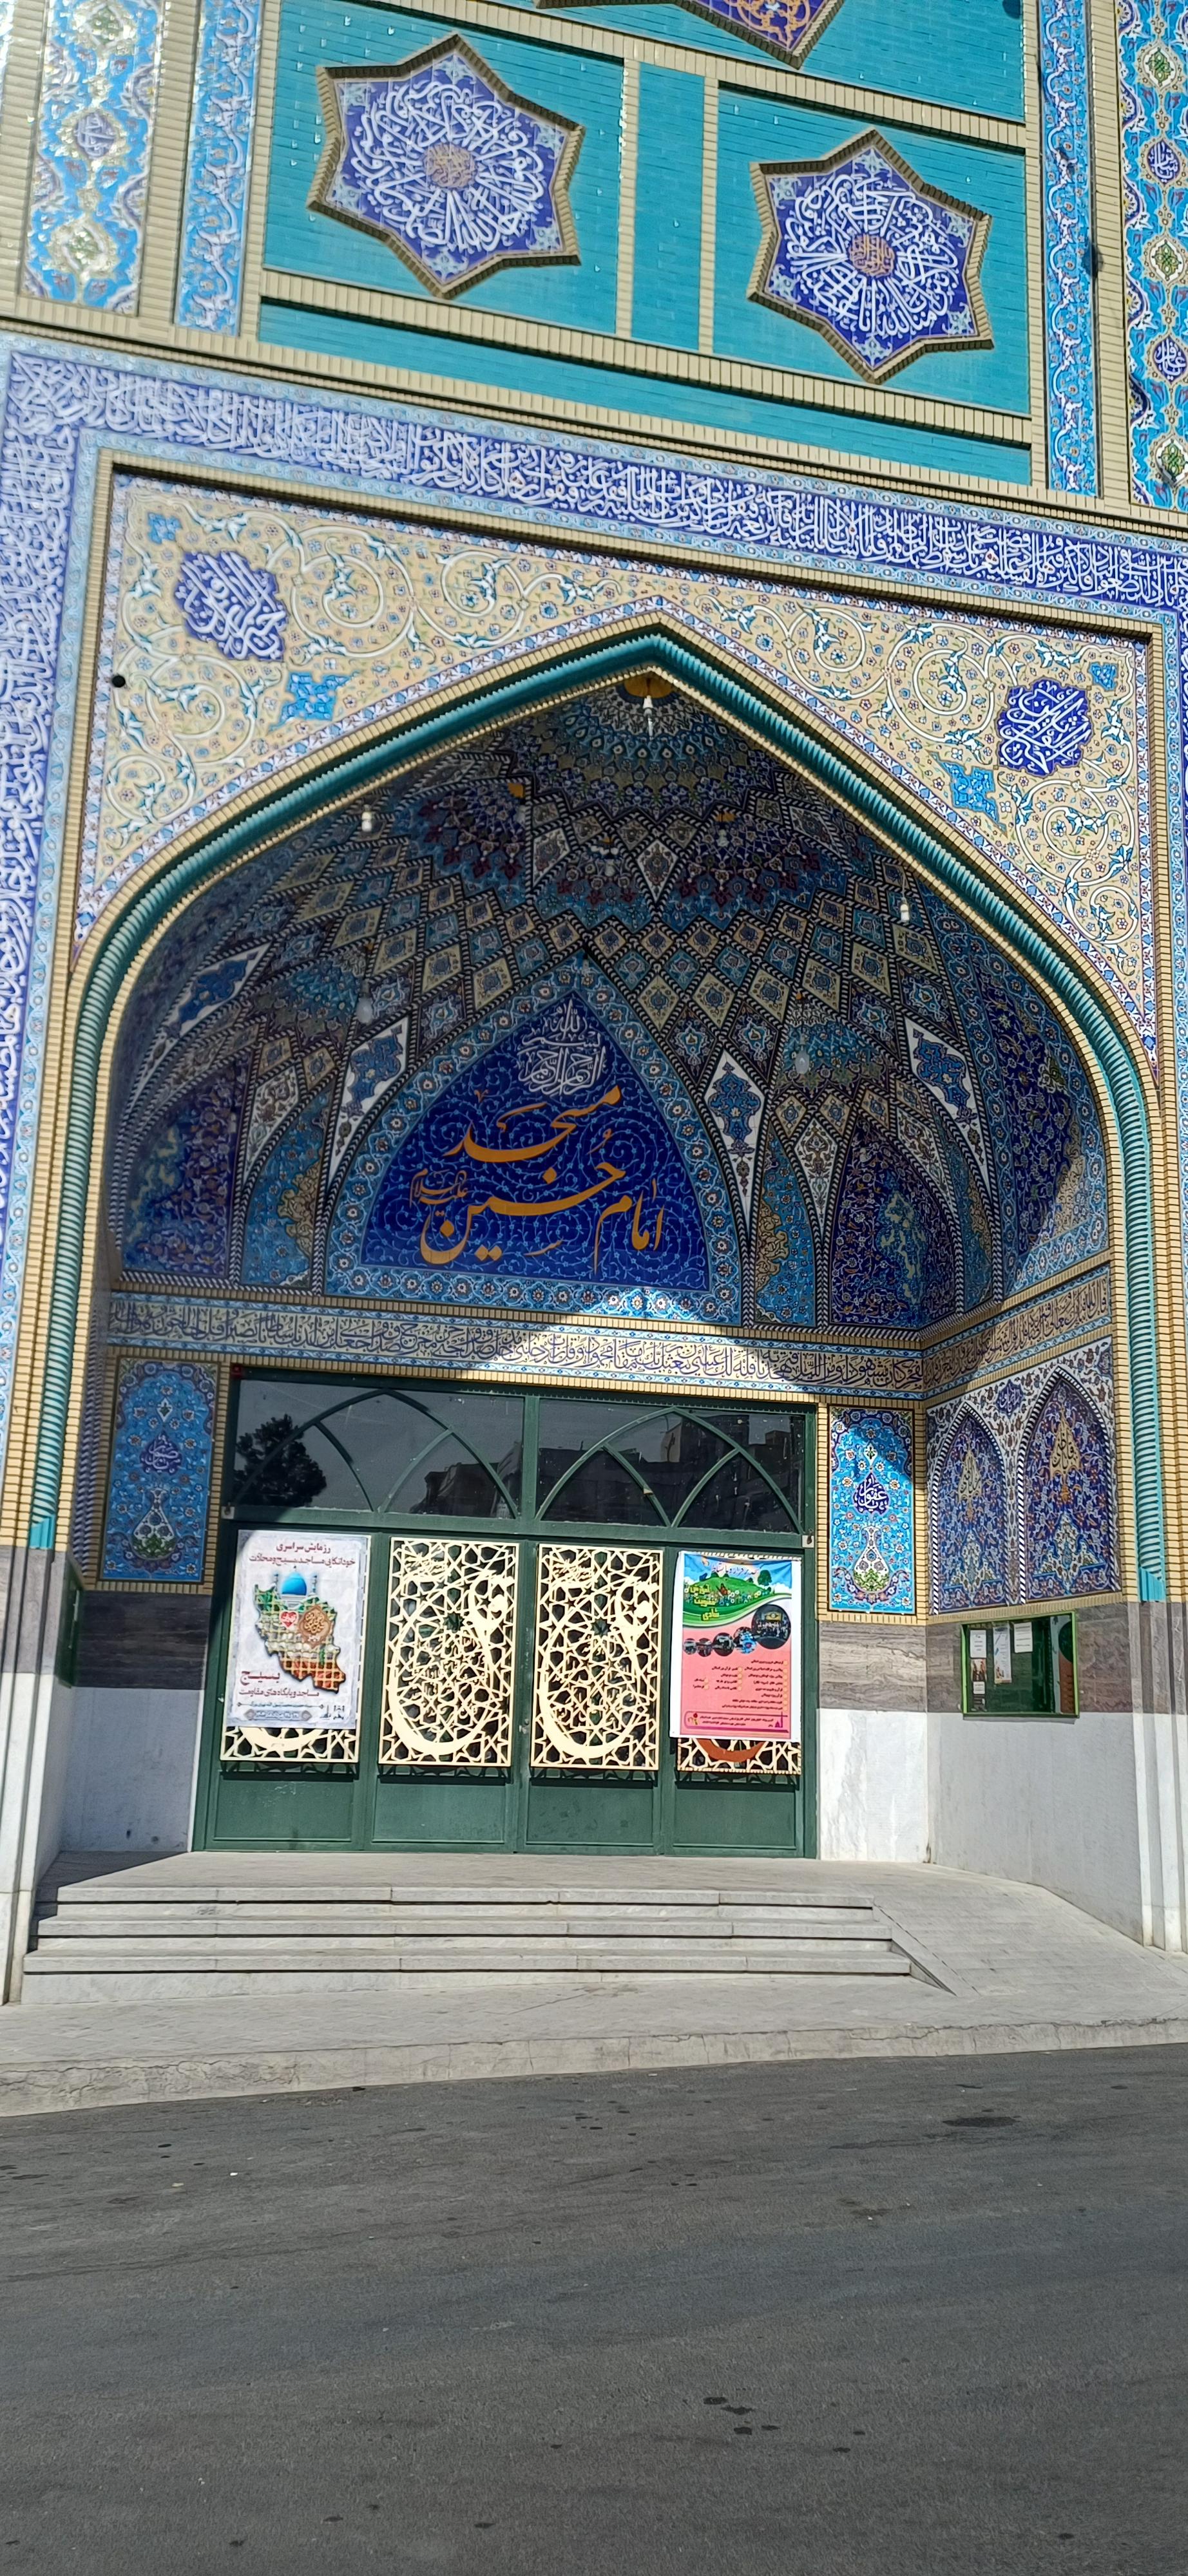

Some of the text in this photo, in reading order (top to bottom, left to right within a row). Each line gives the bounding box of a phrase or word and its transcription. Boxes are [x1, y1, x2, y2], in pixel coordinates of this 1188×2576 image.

[443, 1085, 622, 1163] مسجد
[594, 1191, 666, 1276] امام
[276, 1542, 331, 1553] رزمایش سراسری
[240, 1671, 281, 1686] بسیج
